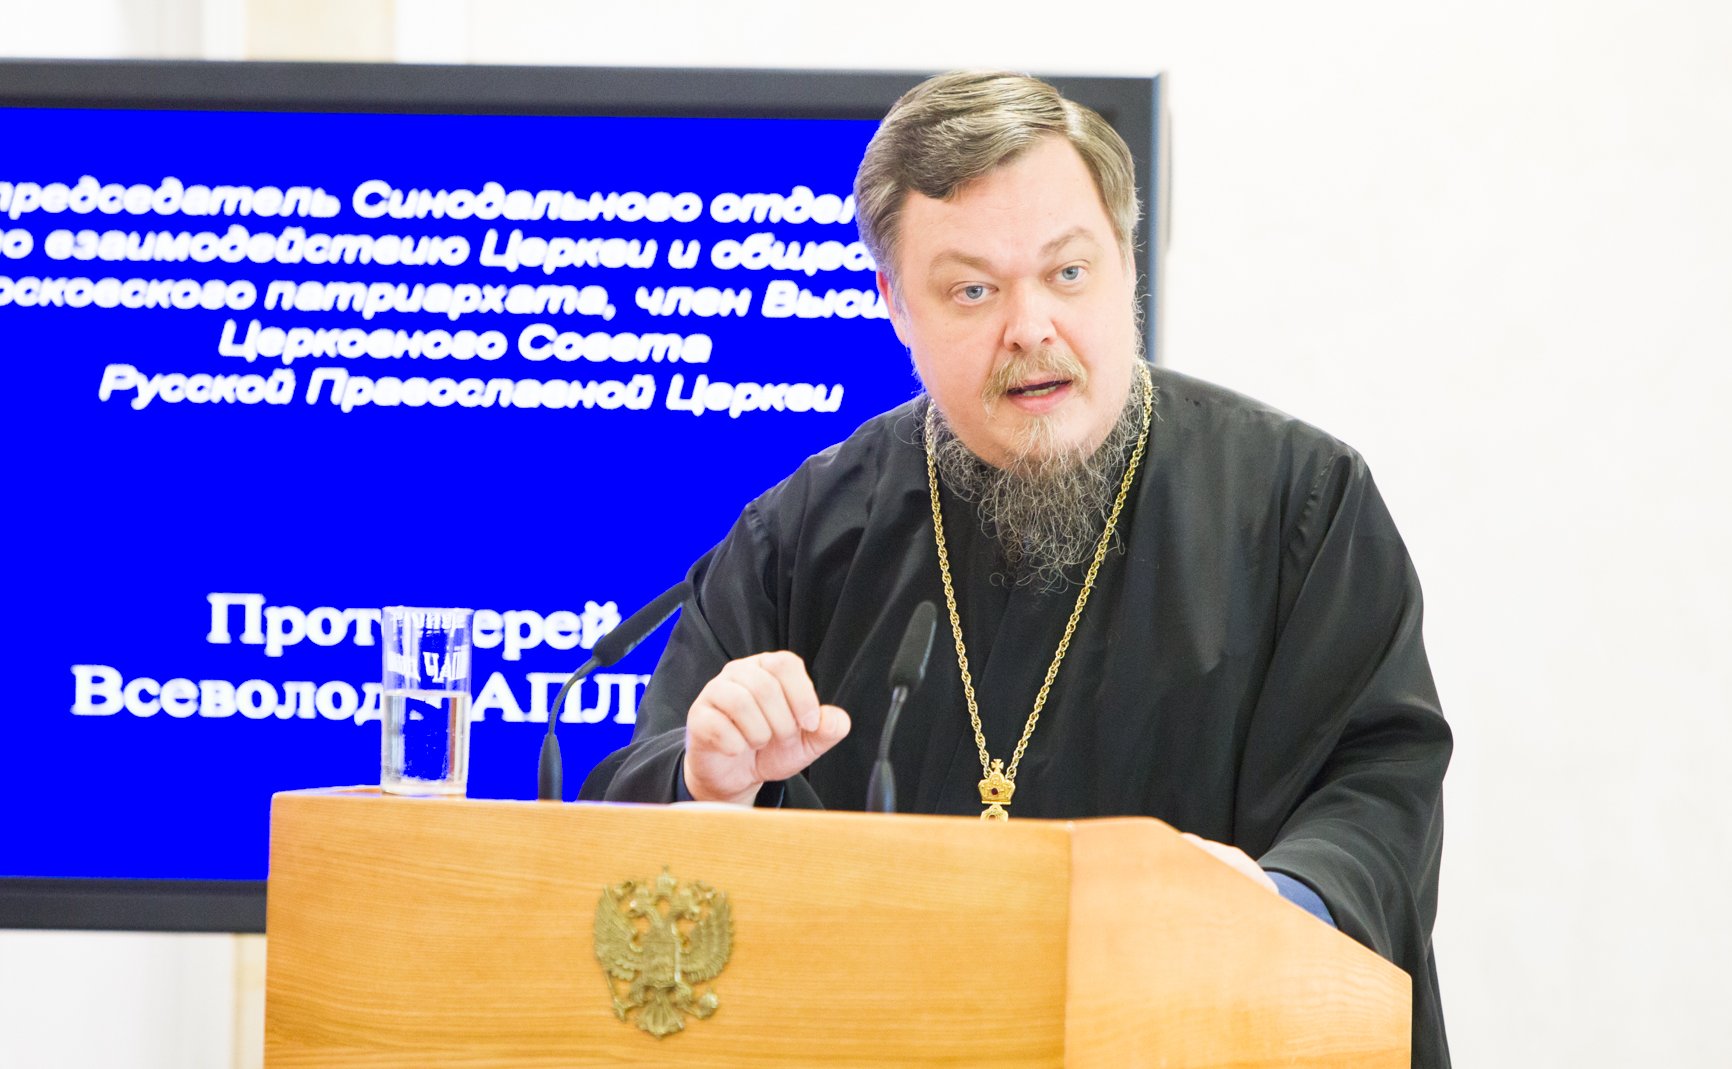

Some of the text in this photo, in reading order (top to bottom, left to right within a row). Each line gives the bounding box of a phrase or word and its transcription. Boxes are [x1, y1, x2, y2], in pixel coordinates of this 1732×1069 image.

[353, 180, 703, 222] Синодального
[0, 229, 34, 260] о
[479, 229, 658, 275] Церкви
[668, 239, 700, 269] и
[711, 232, 876, 276] общес
[264, 280, 616, 321] патриархата,
[635, 287, 752, 317] член
[218, 319, 712, 365] Церковного Совета
[99, 364, 844, 418] Русской Православной Церкви
[207, 593, 621, 661] Протерей
[471, 671, 651, 723] АПЛ
